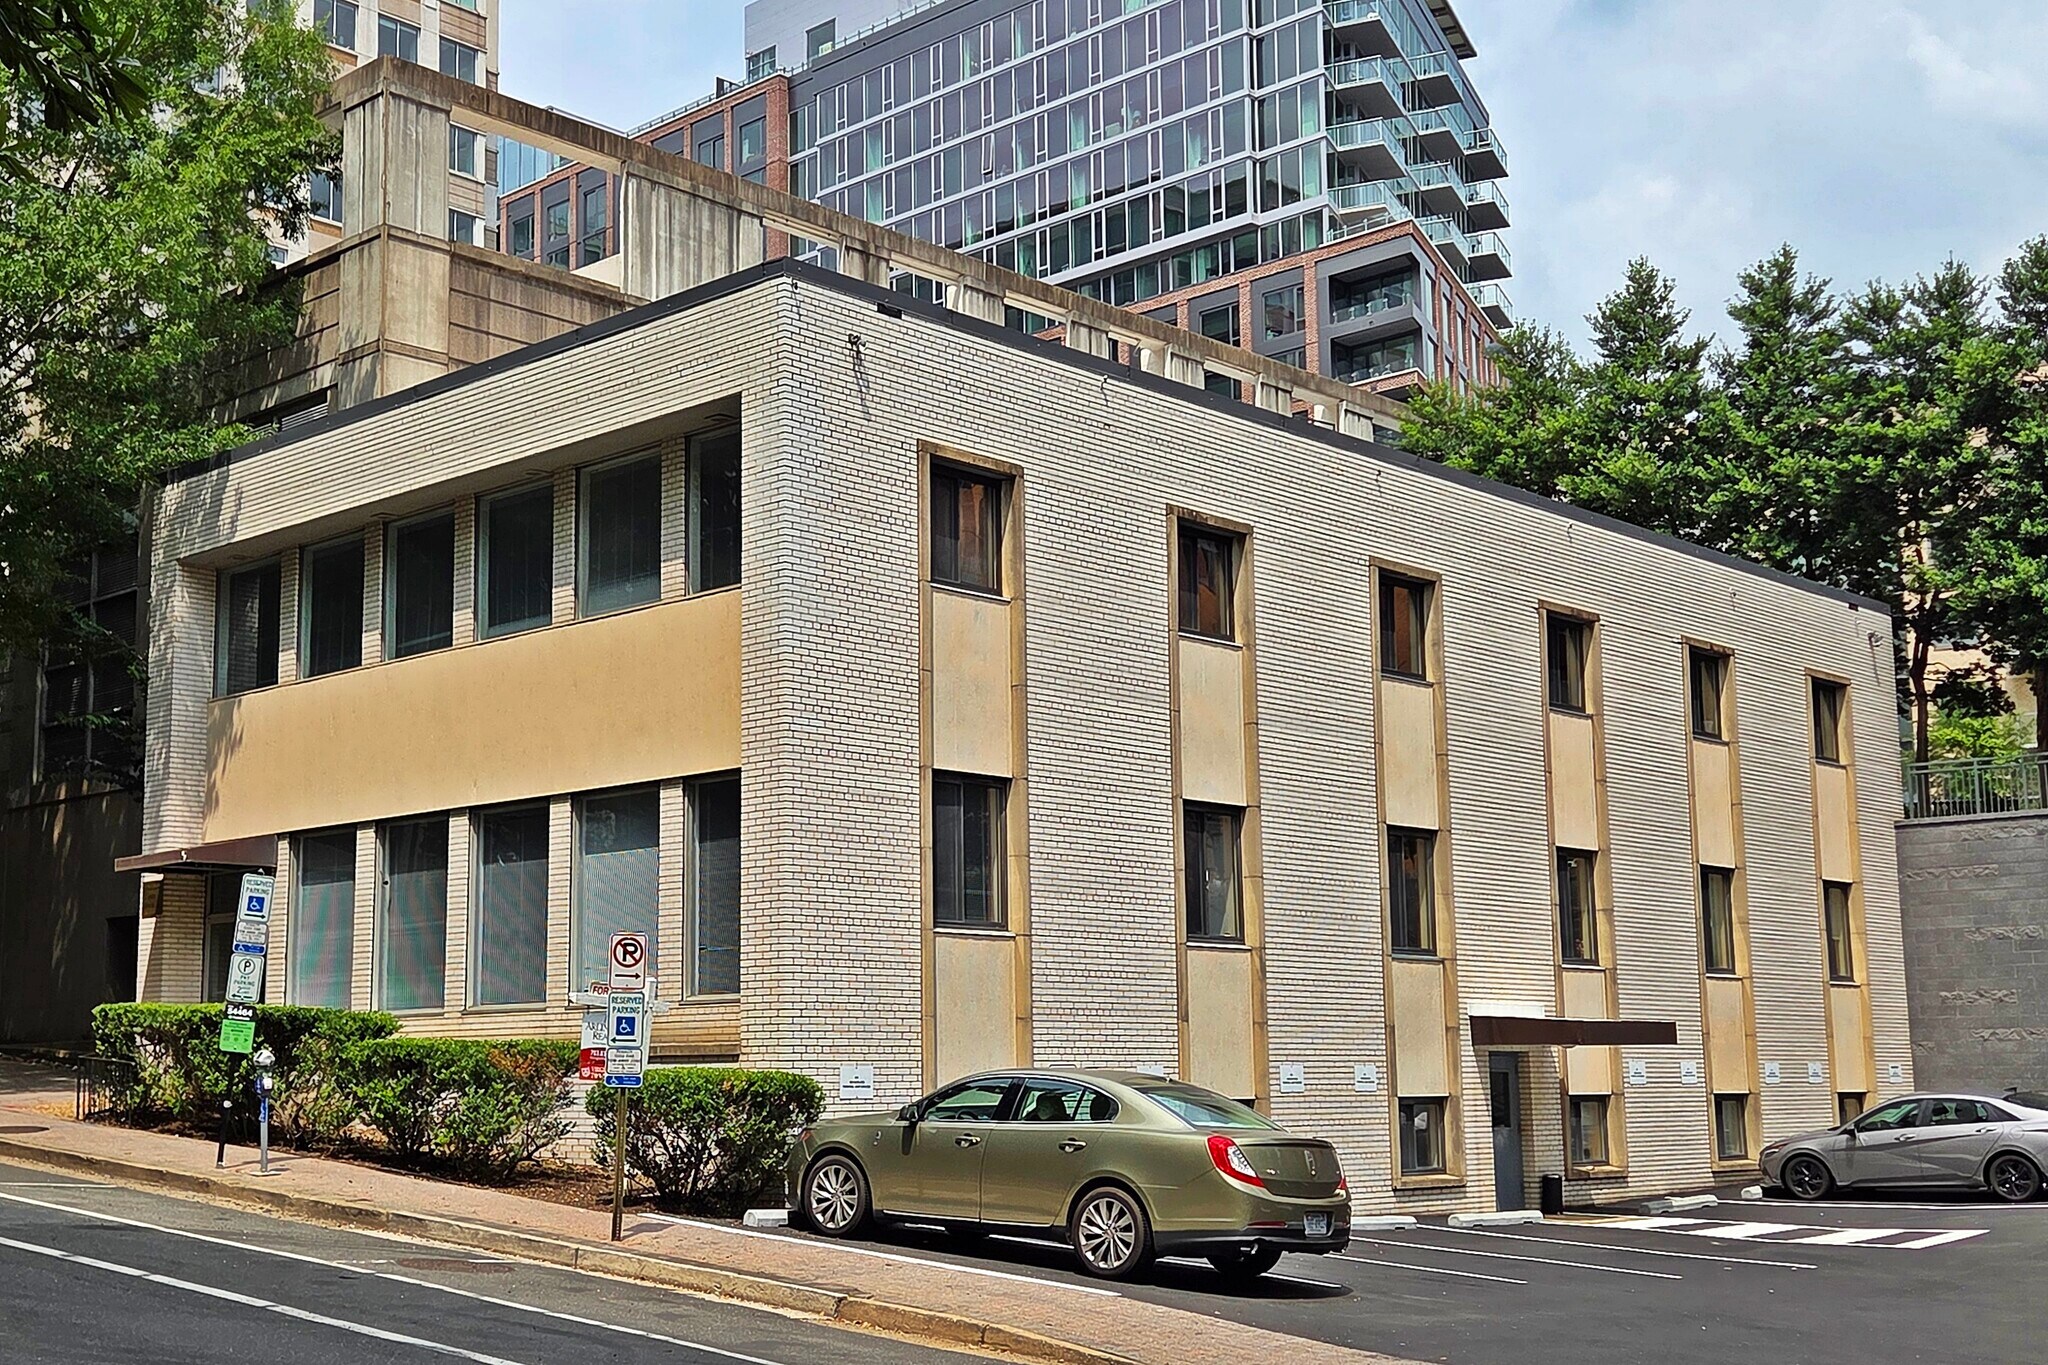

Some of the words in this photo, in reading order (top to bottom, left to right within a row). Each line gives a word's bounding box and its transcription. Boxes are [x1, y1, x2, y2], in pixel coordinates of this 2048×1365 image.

[245, 887, 270, 896] PARKING
[622, 942, 639, 962] P
[243, 960, 251, 972] P
[592, 985, 609, 995] FOR
[611, 996, 642, 1004] RESERVED
[612, 1006, 640, 1014] PARKING
